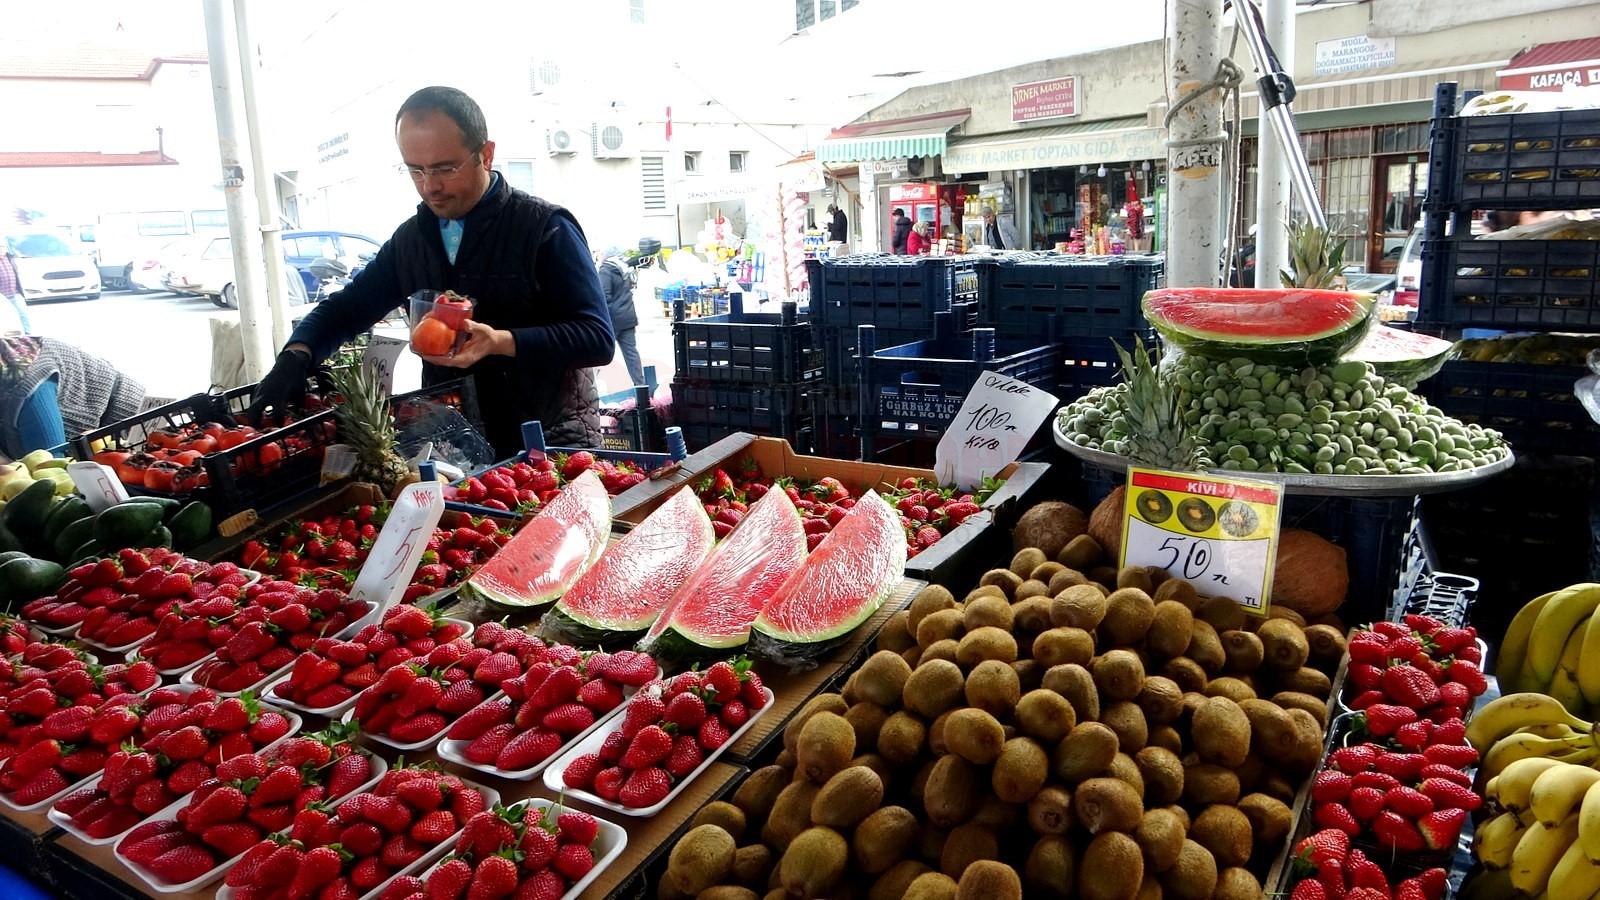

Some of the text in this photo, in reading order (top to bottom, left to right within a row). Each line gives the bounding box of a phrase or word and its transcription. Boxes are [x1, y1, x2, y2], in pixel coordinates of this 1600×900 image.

[1340, 36, 1369, 48] MUĞLA
[1013, 80, 1073, 105] ÖRNEK MARKET
[981, 148, 1028, 165] MARKET
[1030, 143, 1079, 162] TOPTAN
[893, 409, 917, 417] HAL
[919, 410, 936, 419] NO
[1245, 596, 1259, 607] TL
